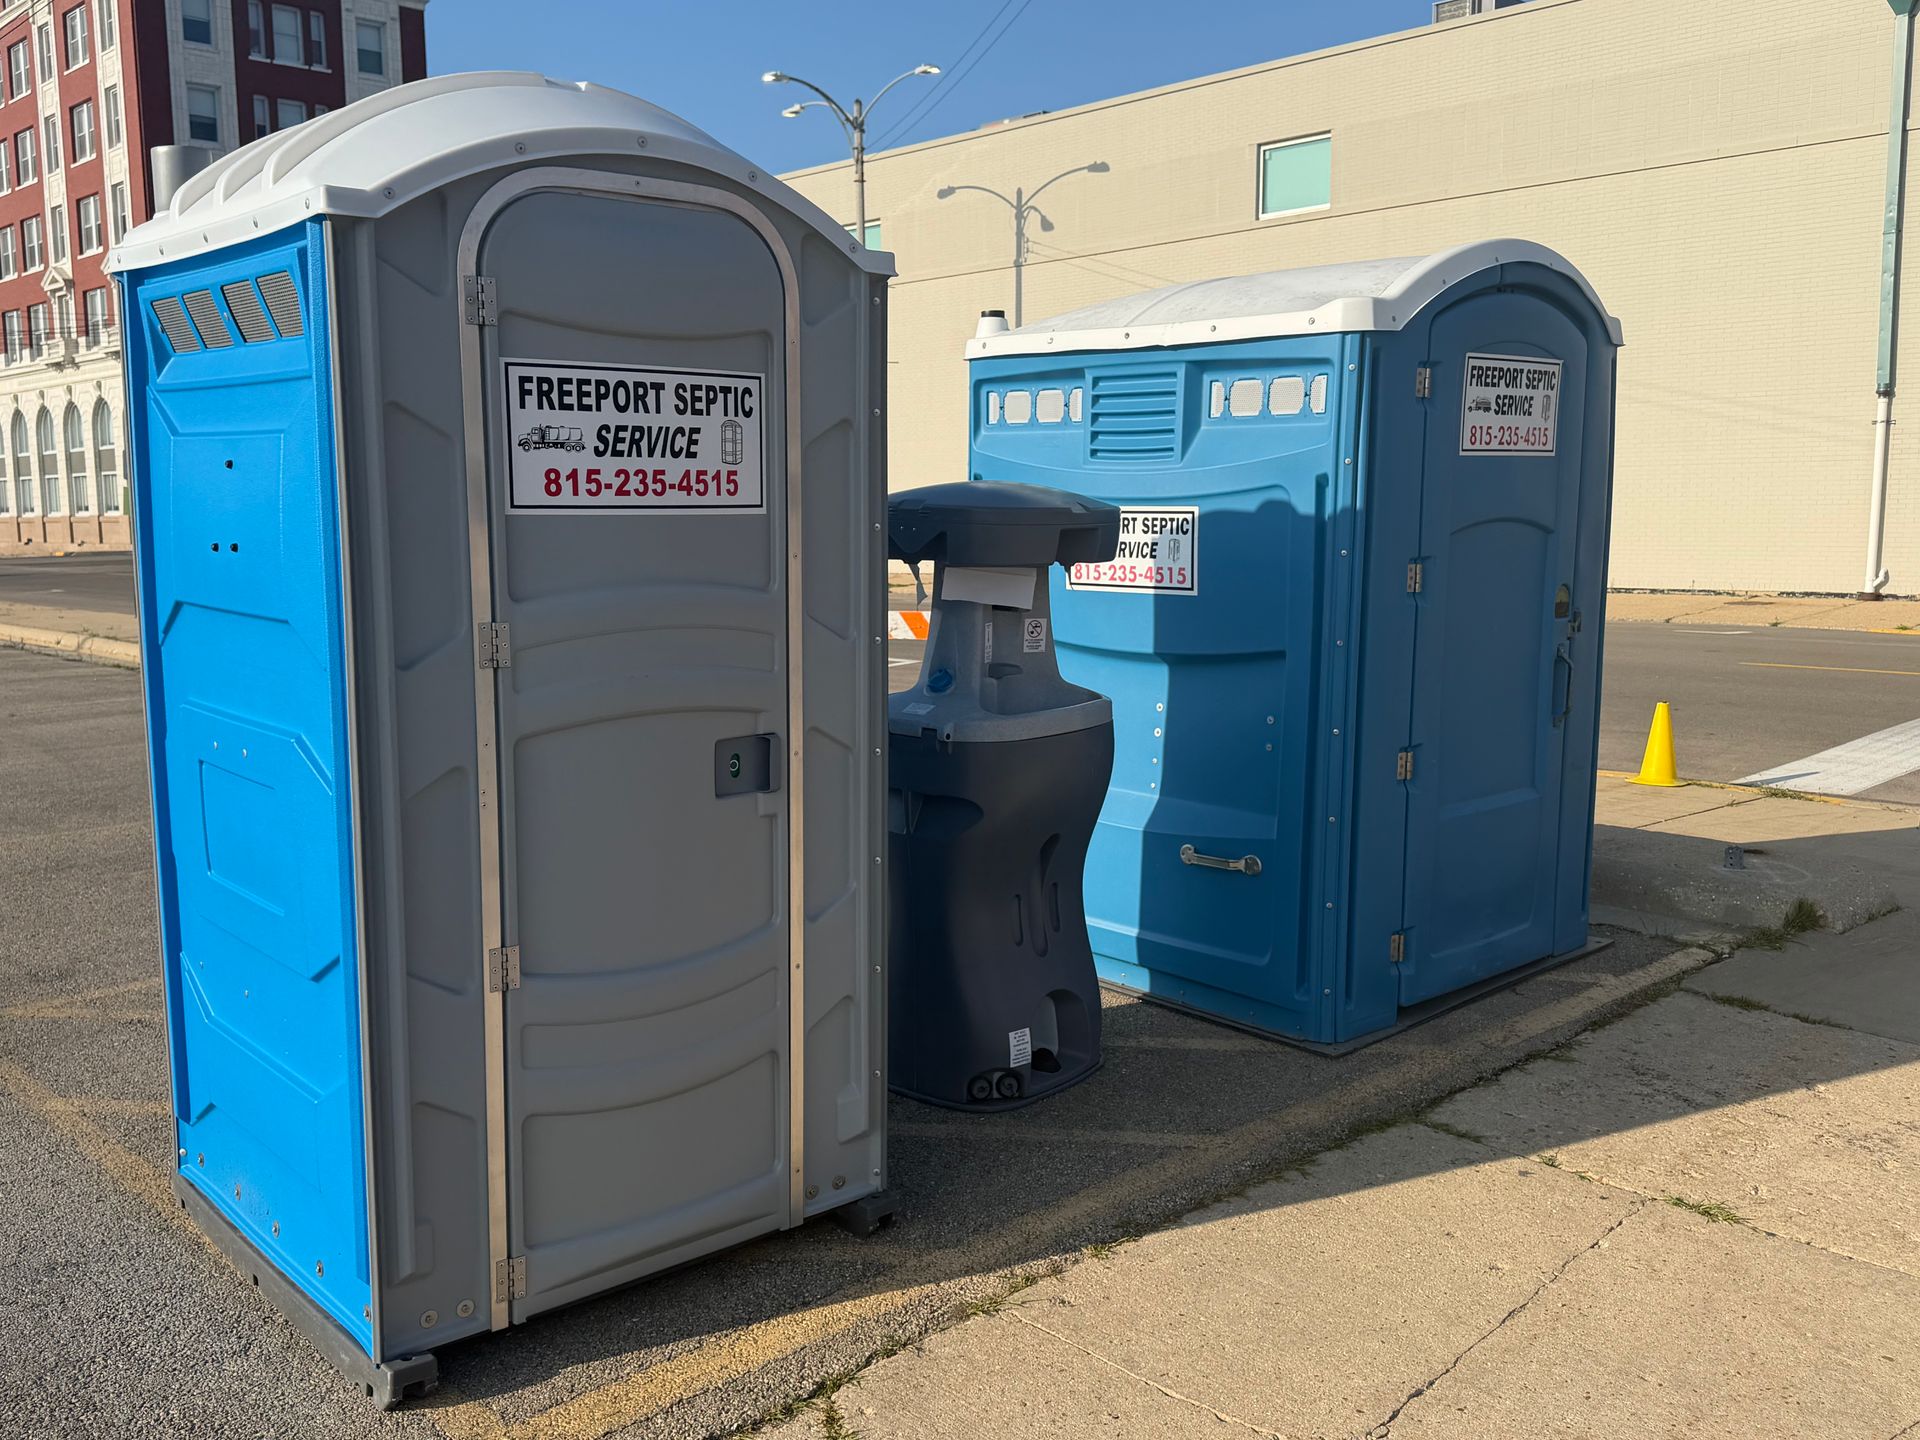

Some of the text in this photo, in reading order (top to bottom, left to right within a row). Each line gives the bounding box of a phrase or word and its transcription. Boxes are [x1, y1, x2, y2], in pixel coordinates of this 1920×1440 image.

[1469, 365, 1556, 391] FREEPORT SEPTIC
[518, 375, 754, 419] FREEPORT SEPTIC
[1493, 394, 1534, 417] SERVICE
[593, 423, 701, 459] SERVICE
[1469, 425, 1549, 447] 815-235-4515
[543, 467, 739, 497] 815-235-4515
[1141, 516, 1190, 536] SEPTIC
[1118, 541, 1159, 559] RVICE
[1074, 563, 1187, 585] 815-235-4515
